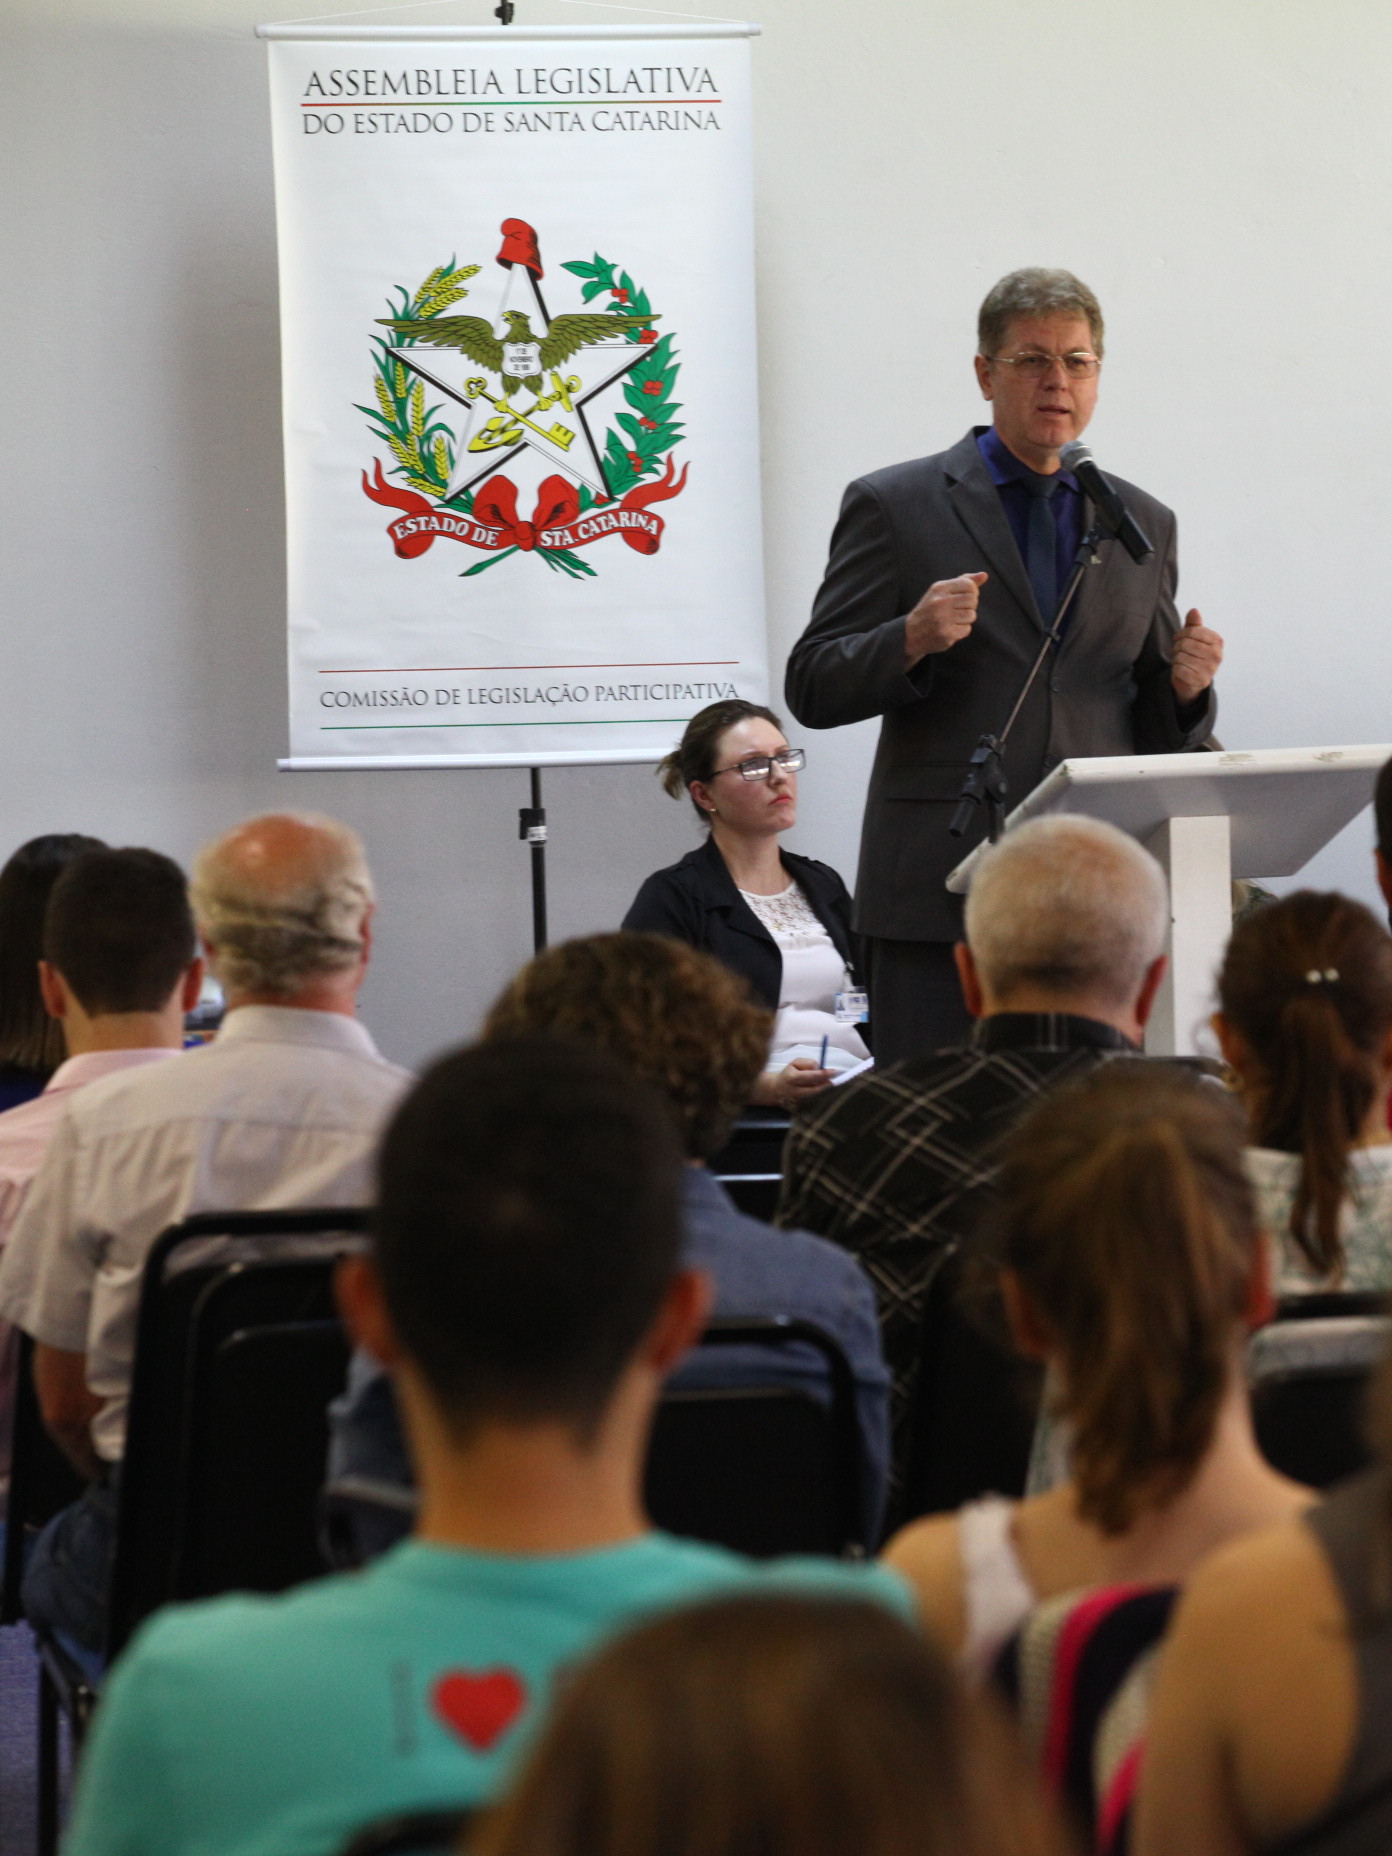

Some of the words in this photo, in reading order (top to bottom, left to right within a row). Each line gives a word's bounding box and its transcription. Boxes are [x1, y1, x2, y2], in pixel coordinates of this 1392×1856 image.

[304, 68, 504, 96] ASSEMBLEIA
[515, 66, 719, 94] LEGISLATIVA
[303, 112, 345, 134] DO
[353, 112, 454, 134] ESTADO
[462, 112, 496, 133] DE
[504, 111, 586, 132] SANTA
[592, 110, 721, 131] CATARINA
[393, 515, 470, 540] ESTADO
[471, 526, 500, 547] DE
[540, 529, 579, 548] STA.
[579, 510, 659, 538] CATARINA
[320, 686, 429, 708] COMISSÃO
[435, 688, 462, 706] DE
[468, 684, 589, 707] LEGISLAÇÃO
[595, 682, 739, 702] PARTICIPATIVA
